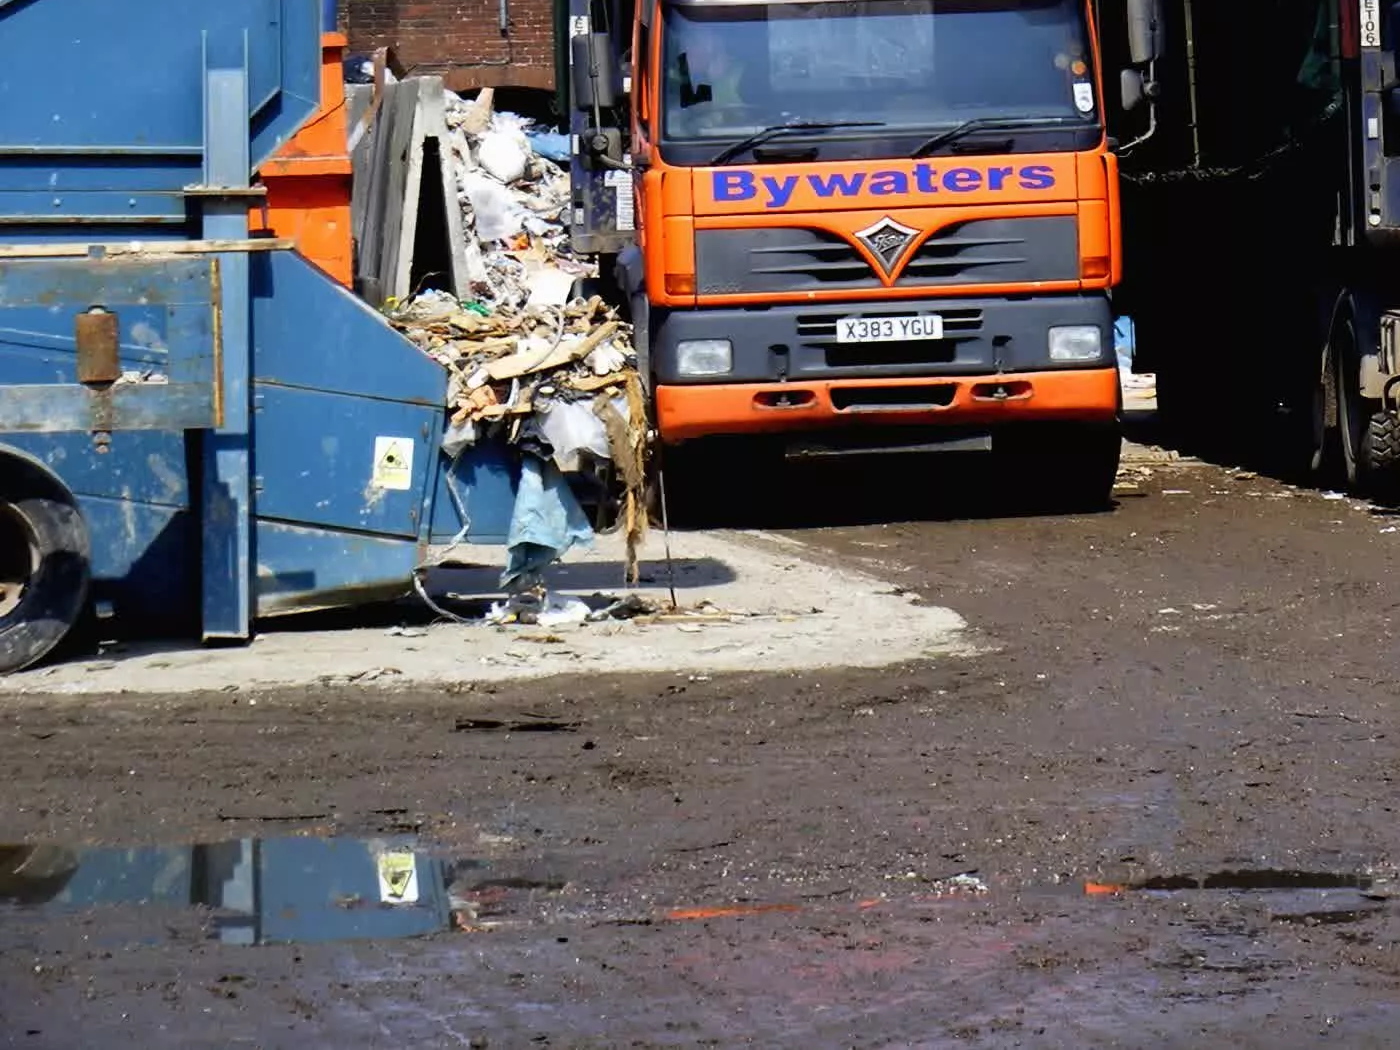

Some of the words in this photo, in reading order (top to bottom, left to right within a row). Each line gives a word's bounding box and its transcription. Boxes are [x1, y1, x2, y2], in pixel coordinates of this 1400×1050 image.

[711, 162, 1056, 208] Bywaters
[846, 320, 893, 339] X383
[900, 318, 935, 337] YGU
